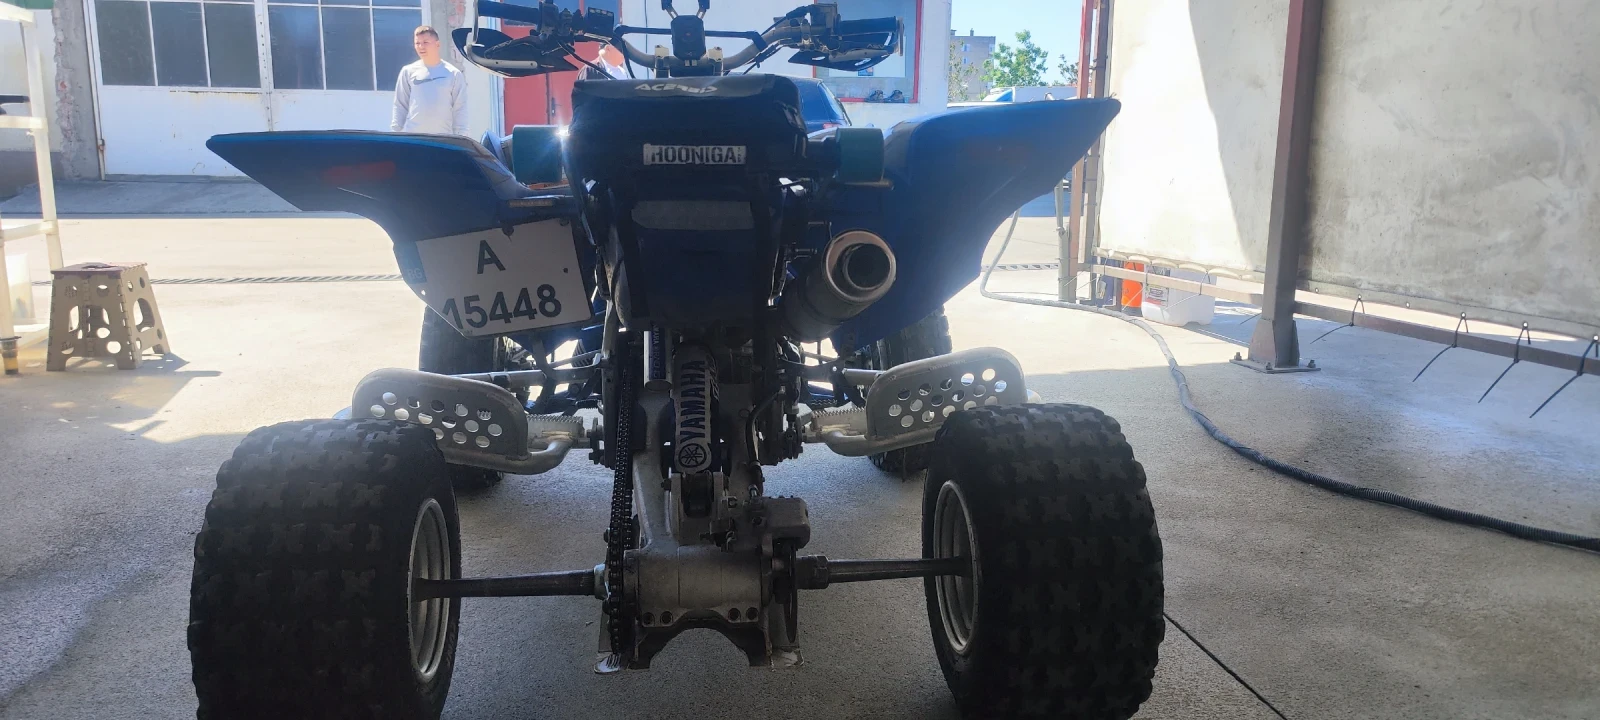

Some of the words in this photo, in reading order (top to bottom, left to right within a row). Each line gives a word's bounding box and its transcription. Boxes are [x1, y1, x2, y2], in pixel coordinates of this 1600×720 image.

[477, 240, 506, 274] A
[442, 284, 562, 330] 15448
[679, 360, 706, 444] YAMAHA
